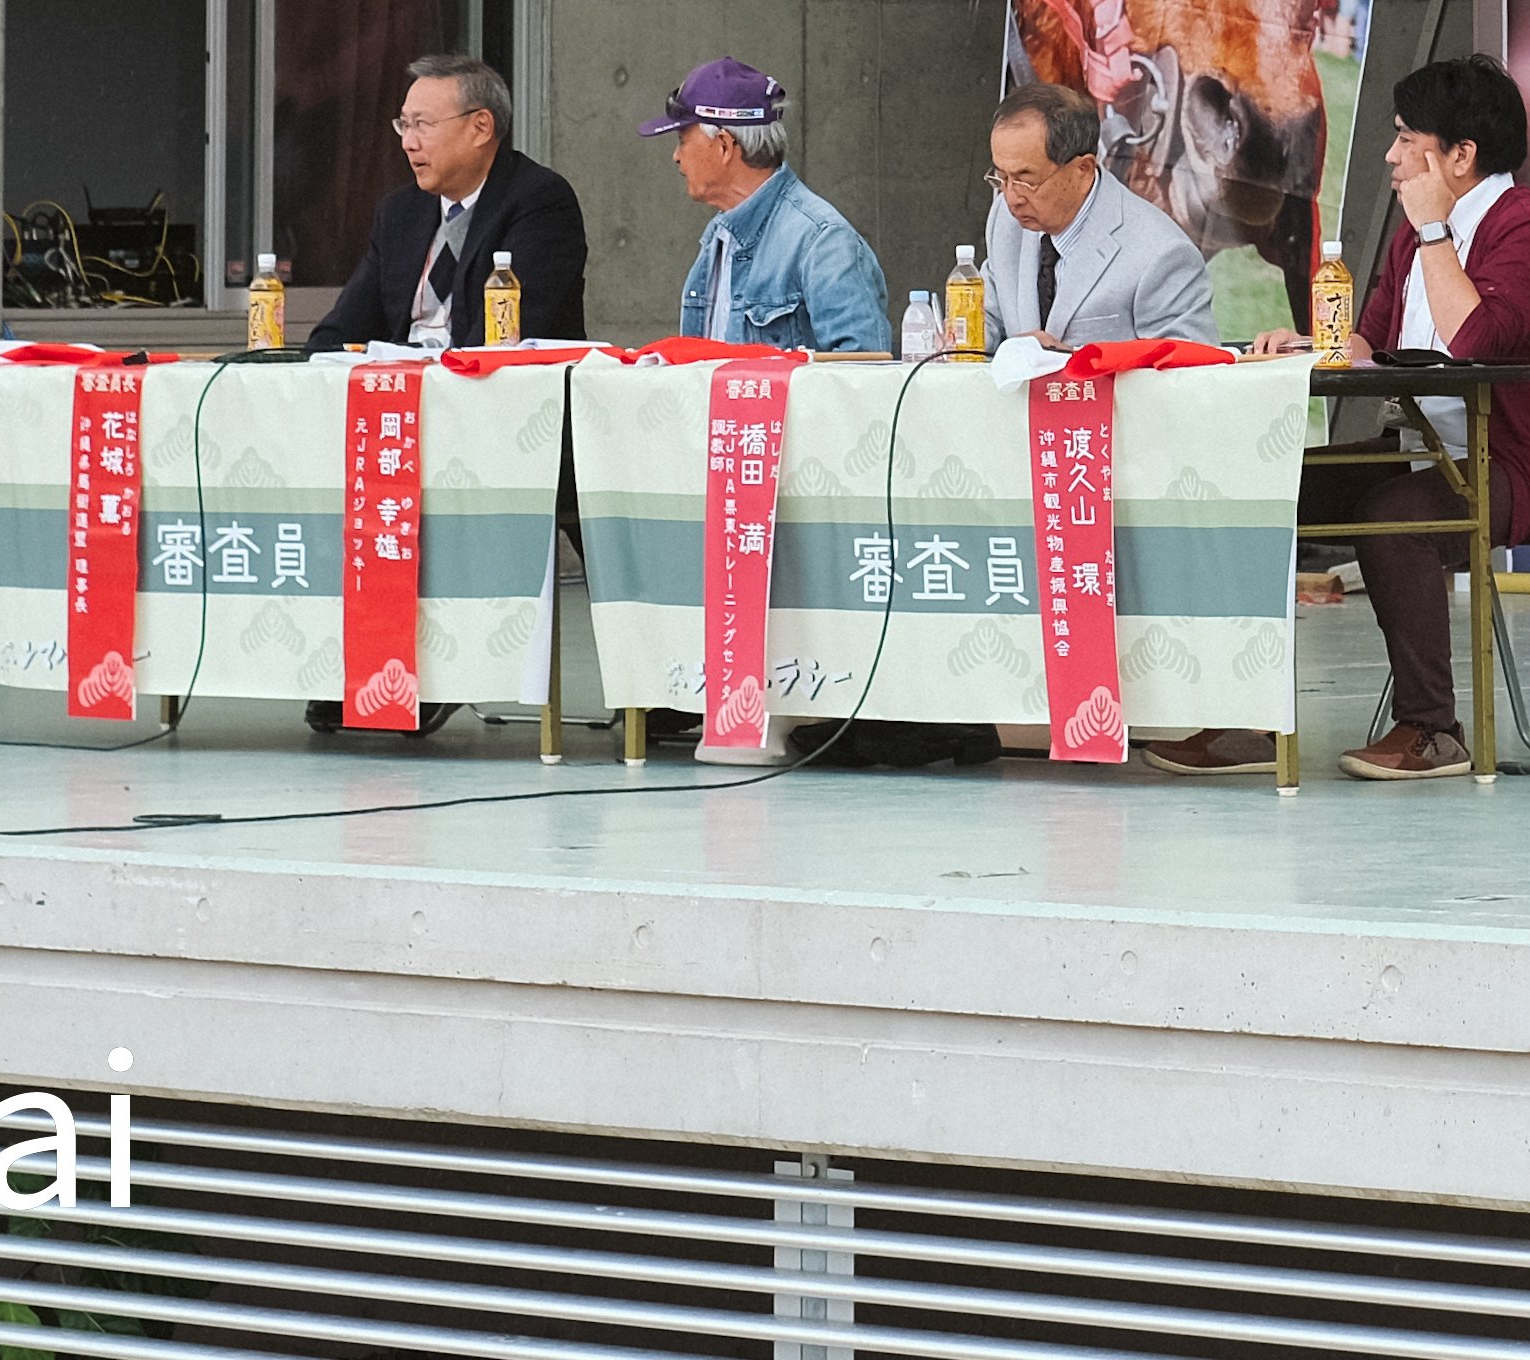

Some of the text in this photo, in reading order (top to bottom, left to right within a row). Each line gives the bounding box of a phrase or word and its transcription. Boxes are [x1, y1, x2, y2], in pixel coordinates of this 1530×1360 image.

[726, 379, 772, 400] 審査員
[1044, 380, 1097, 403] 審査員
[374, 412, 402, 560] 岡部 幸雄
[738, 423, 767, 556] 橋田 満
[1063, 428, 1102, 597] 渡久山 環
[152, 518, 310, 589] 審査員
[849, 531, 1031, 606] 審査員
